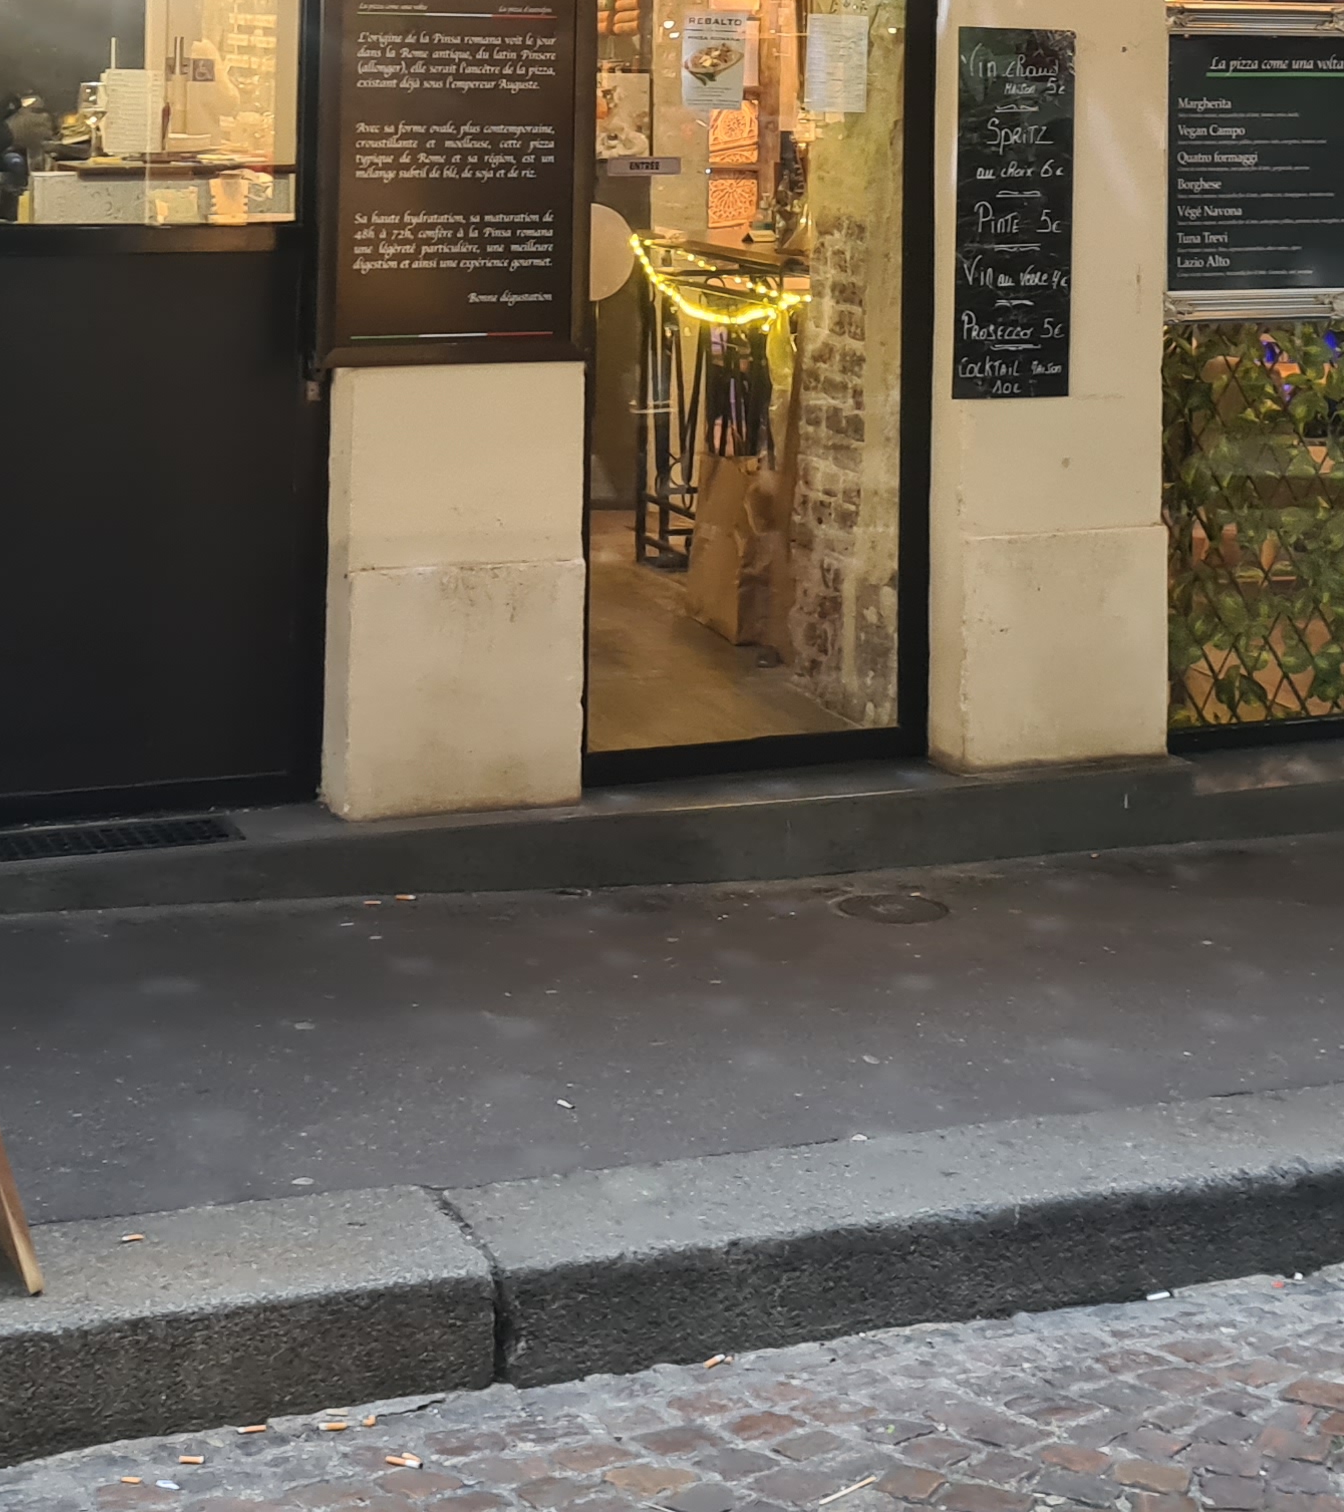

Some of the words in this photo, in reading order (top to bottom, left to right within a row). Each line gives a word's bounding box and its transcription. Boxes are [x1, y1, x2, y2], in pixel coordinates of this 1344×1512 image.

[1209, 57, 1225, 70] La
[1226, 57, 1258, 76] pizza
[1261, 59, 1289, 70] come
[1292, 59, 1313, 70] una
[1317, 54, 1344, 70] volta
[1177, 98, 1232, 112] Margherita
[1177, 124, 1207, 138] Vegan
